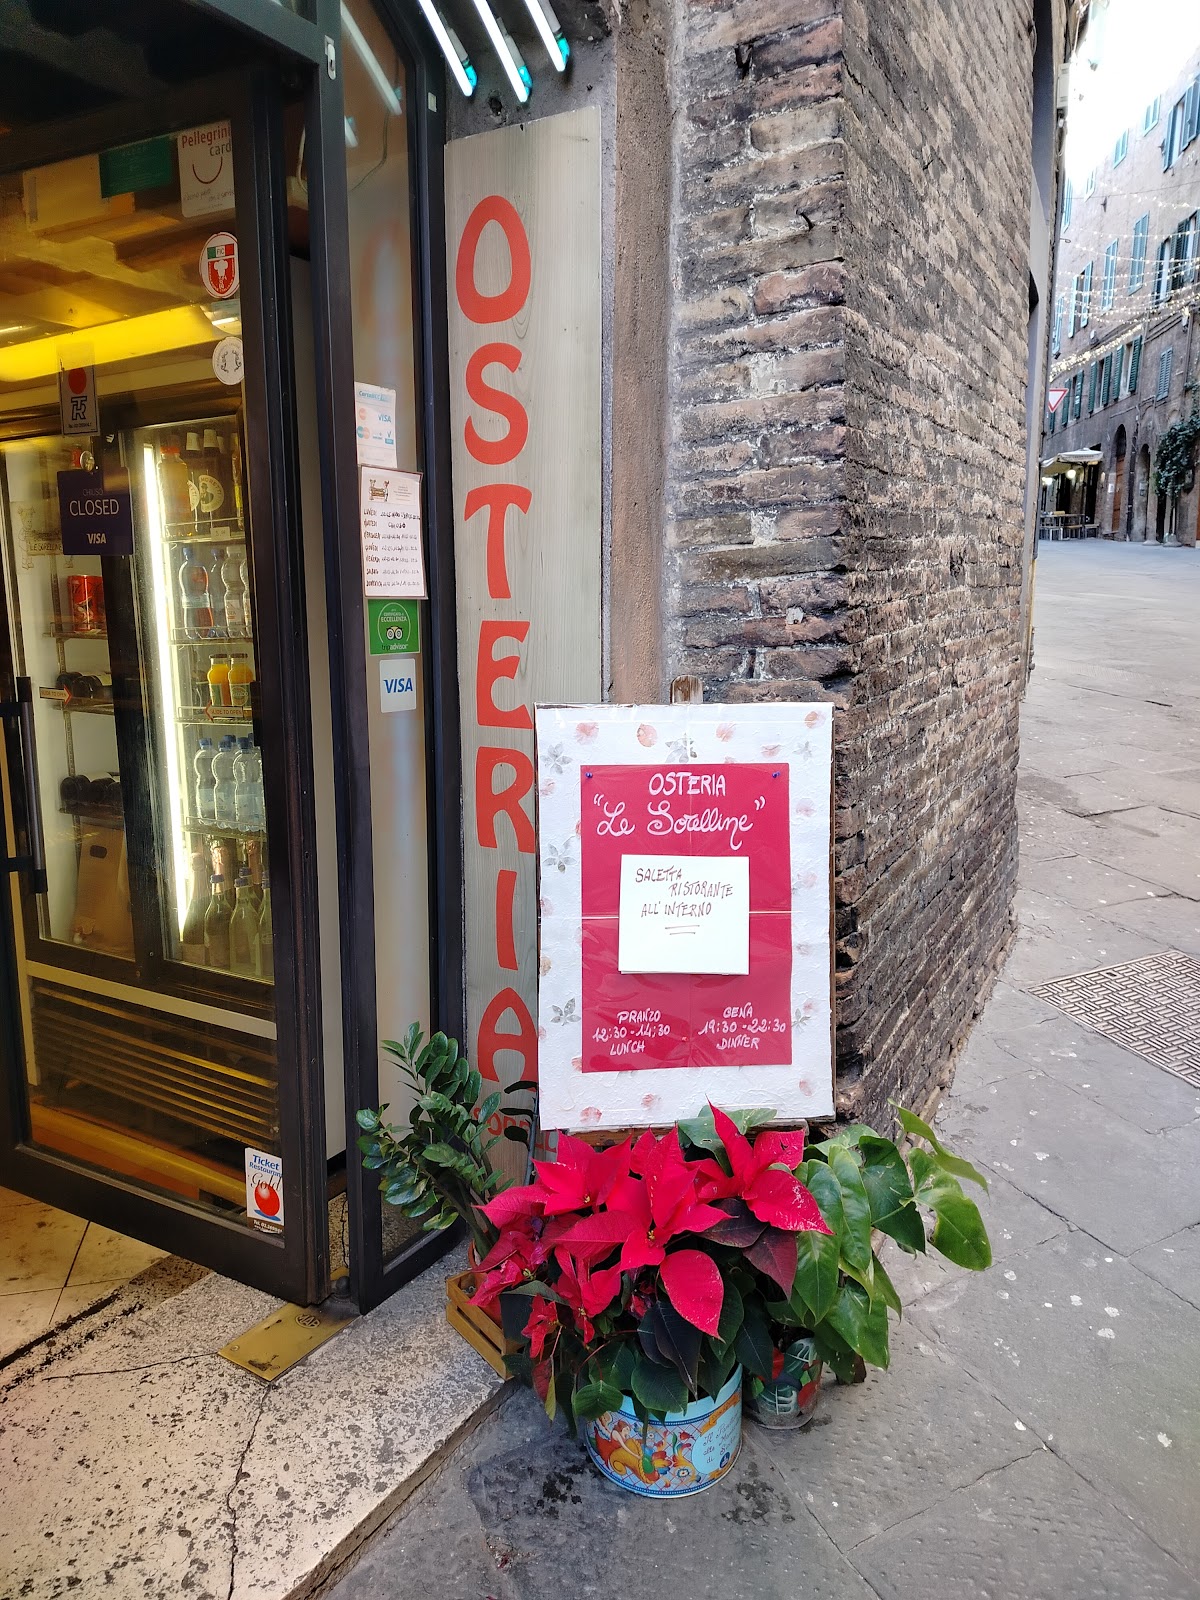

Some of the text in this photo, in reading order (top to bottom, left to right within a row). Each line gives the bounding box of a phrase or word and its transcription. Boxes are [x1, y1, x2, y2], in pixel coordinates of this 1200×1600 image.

[209, 138, 231, 156] card
[378, 414, 391, 423] VISA
[69, 498, 120, 516] CLOSED
[86, 533, 107, 545] VISA
[456, 195, 538, 1093] OSTERIA
[383, 677, 413, 694] VISA
[648, 771, 726, 797] OSTERIA
[635, 865, 683, 883] SALETTA
[668, 880, 734, 899] RISTORANTE
[616, 1008, 662, 1024] PRANZO
[609, 1039, 646, 1056] LUNCH
[716, 1034, 761, 1050] DINNER
[253, 1154, 280, 1171] Ticket
[250, 1172, 282, 1191] Gold
